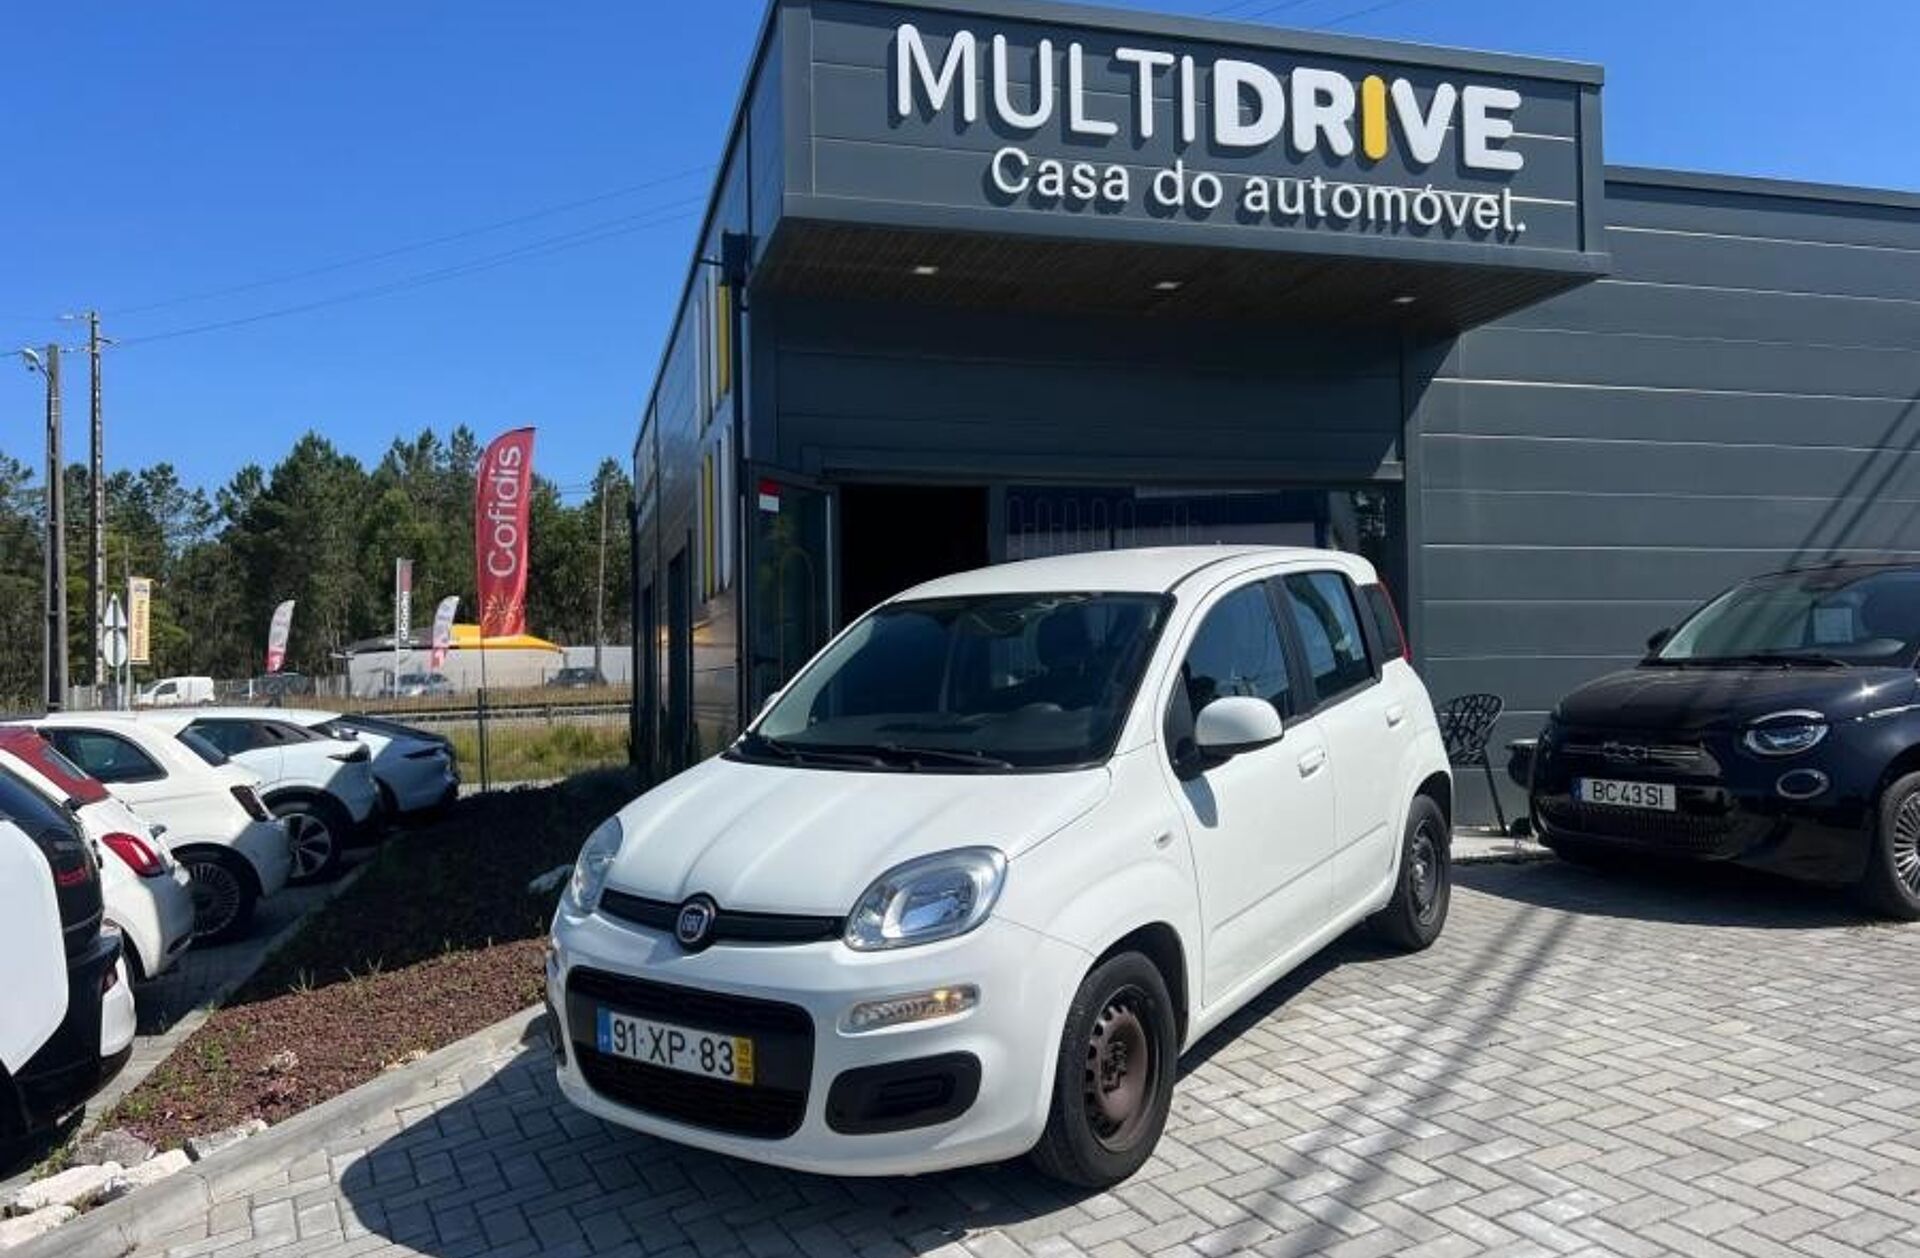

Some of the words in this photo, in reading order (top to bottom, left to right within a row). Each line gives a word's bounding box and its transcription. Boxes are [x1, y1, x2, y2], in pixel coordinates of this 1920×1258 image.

[991, 146, 1130, 202] Casa
[1152, 159, 1223, 209] do
[1244, 176, 1526, 232] automóvel.
[487, 445, 522, 577] Cofidis
